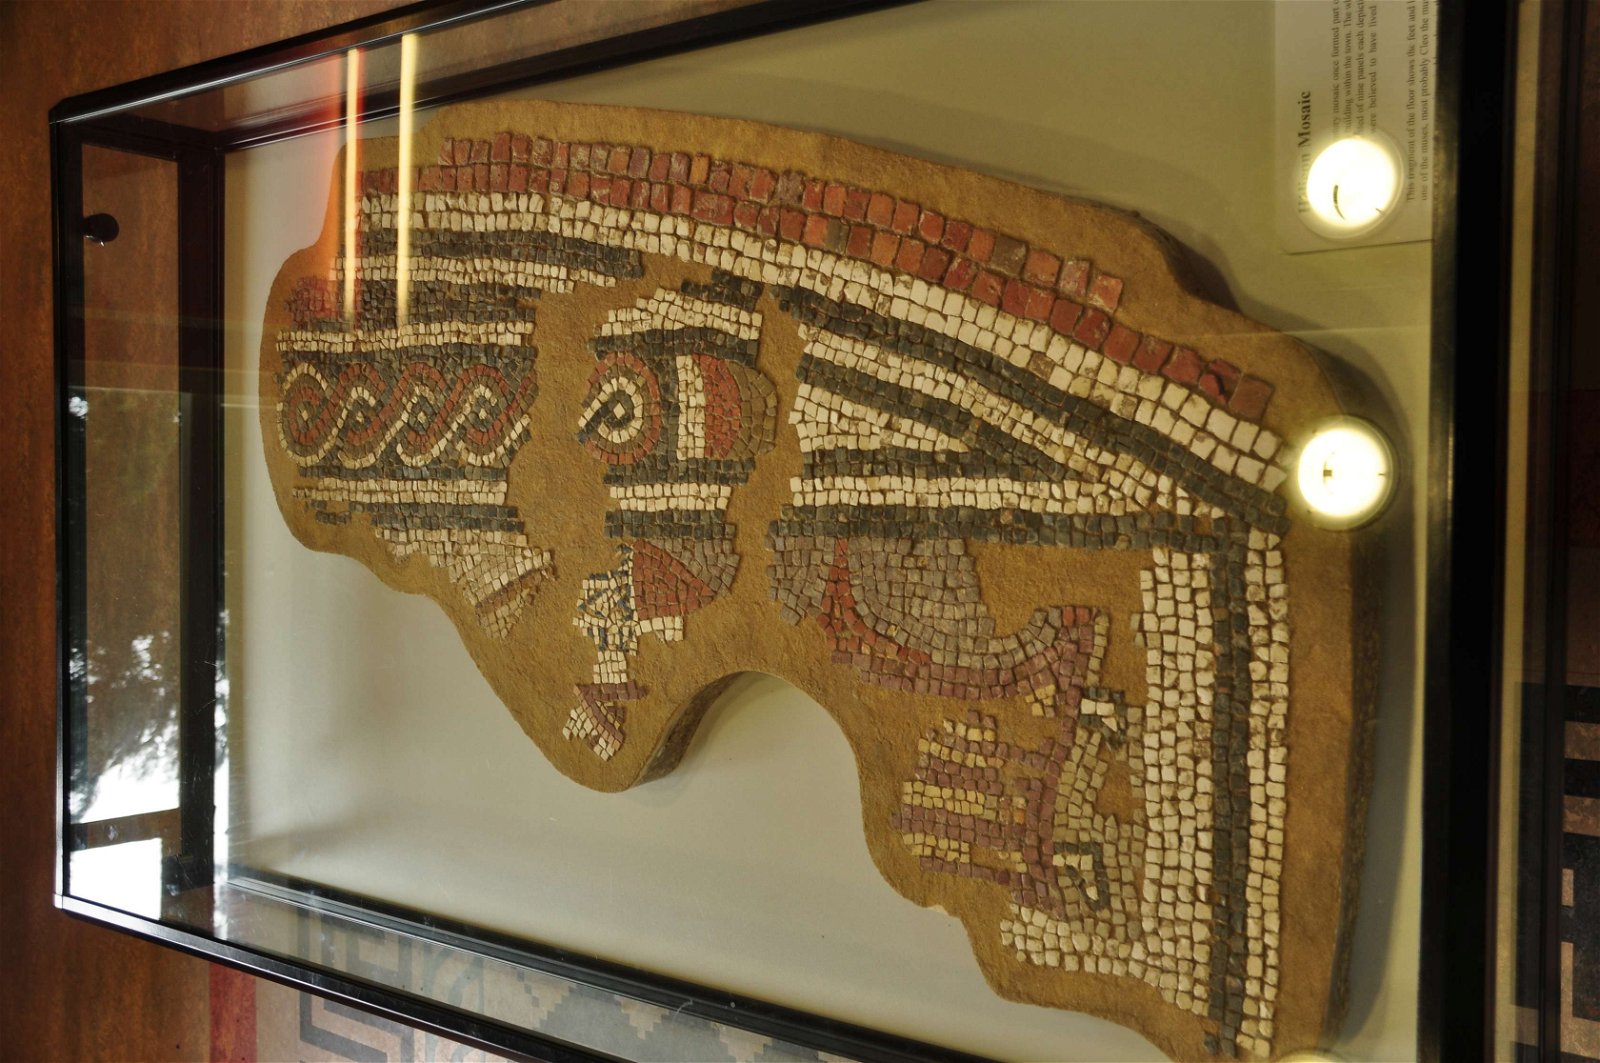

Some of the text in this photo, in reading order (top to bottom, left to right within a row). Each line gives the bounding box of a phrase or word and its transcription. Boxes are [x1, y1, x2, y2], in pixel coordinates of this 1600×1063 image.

[1332, 8, 1341, 24] part
[1343, 12, 1352, 27] The
[1368, 5, 1377, 27] lived
[1406, 6, 1415, 22] and
[1406, 25, 1415, 41] feet
[1419, 18, 1429, 32] the
[1330, 27, 1340, 57] formed
[1344, 31, 1352, 54] town.
[1355, 30, 1364, 50] each
[1368, 32, 1377, 53] have
[1419, 34, 1429, 56] Cleo
[1406, 44, 1415, 57] the
[1332, 60, 1340, 80] once
[1343, 56, 1352, 69] the
[1355, 53, 1366, 80] panels
[1369, 58, 1377, 67] to
[1406, 59, 1415, 86] shows
[1343, 71, 1352, 97] within
[1419, 58, 1430, 97] probably
[1331, 83, 1340, 113] mosaic
[1356, 83, 1364, 101] nine
[1368, 72, 1377, 109] believed
[1406, 89, 1415, 110] floor
[1355, 104, 1364, 113] of
[1420, 100, 1428, 121] most
[1297, 91, 1311, 147] Mosaic
[1406, 113, 1415, 126] the
[1406, 128, 1415, 138] of
[1420, 123, 1429, 153] muses,
[1406, 140, 1417, 180] fragment
[1419, 156, 1428, 170] the
[1419, 172, 1428, 182] of
[1406, 182, 1415, 201] This
